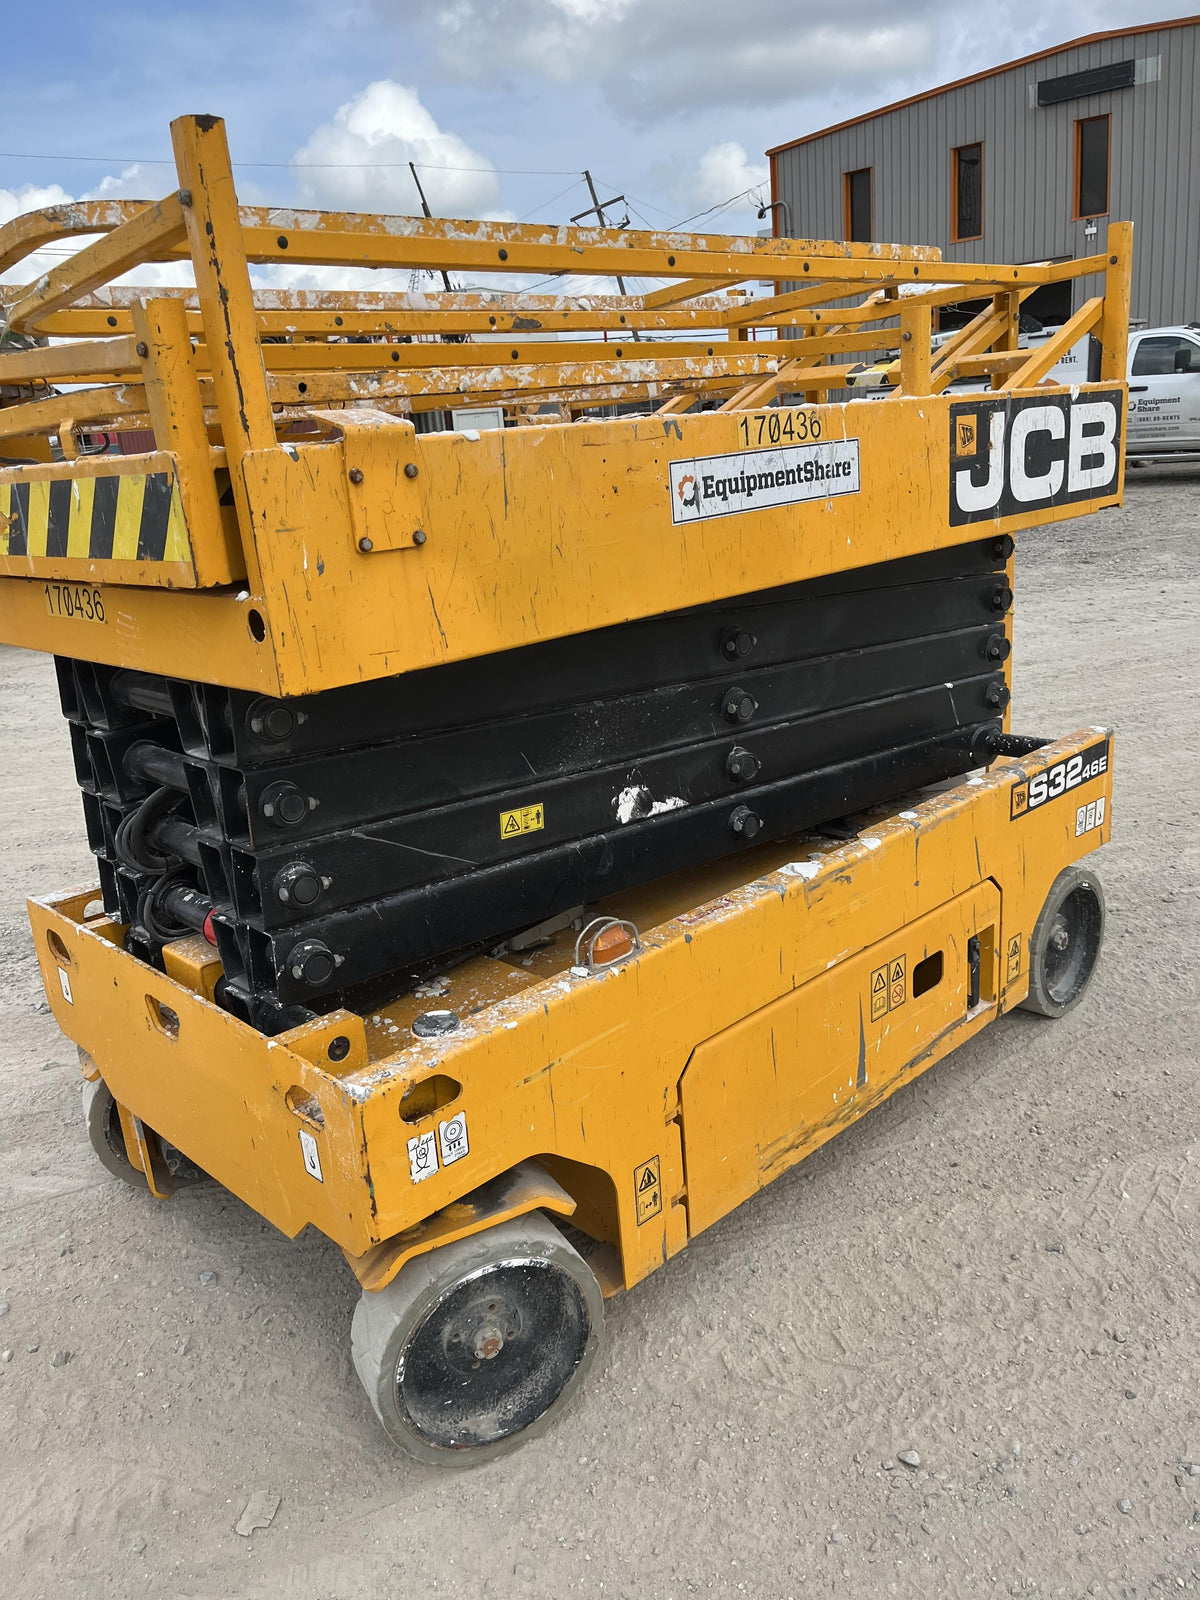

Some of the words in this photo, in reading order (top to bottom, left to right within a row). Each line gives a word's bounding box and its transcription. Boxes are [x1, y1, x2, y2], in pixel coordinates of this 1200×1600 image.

[1137, 397, 1181, 406] Equipment
[740, 411, 822, 447] 170436
[961, 426, 974, 446] JCB
[955, 401, 1117, 512] JCB
[701, 459, 852, 502] EquipmentShare
[45, 584, 105, 622] 170436
